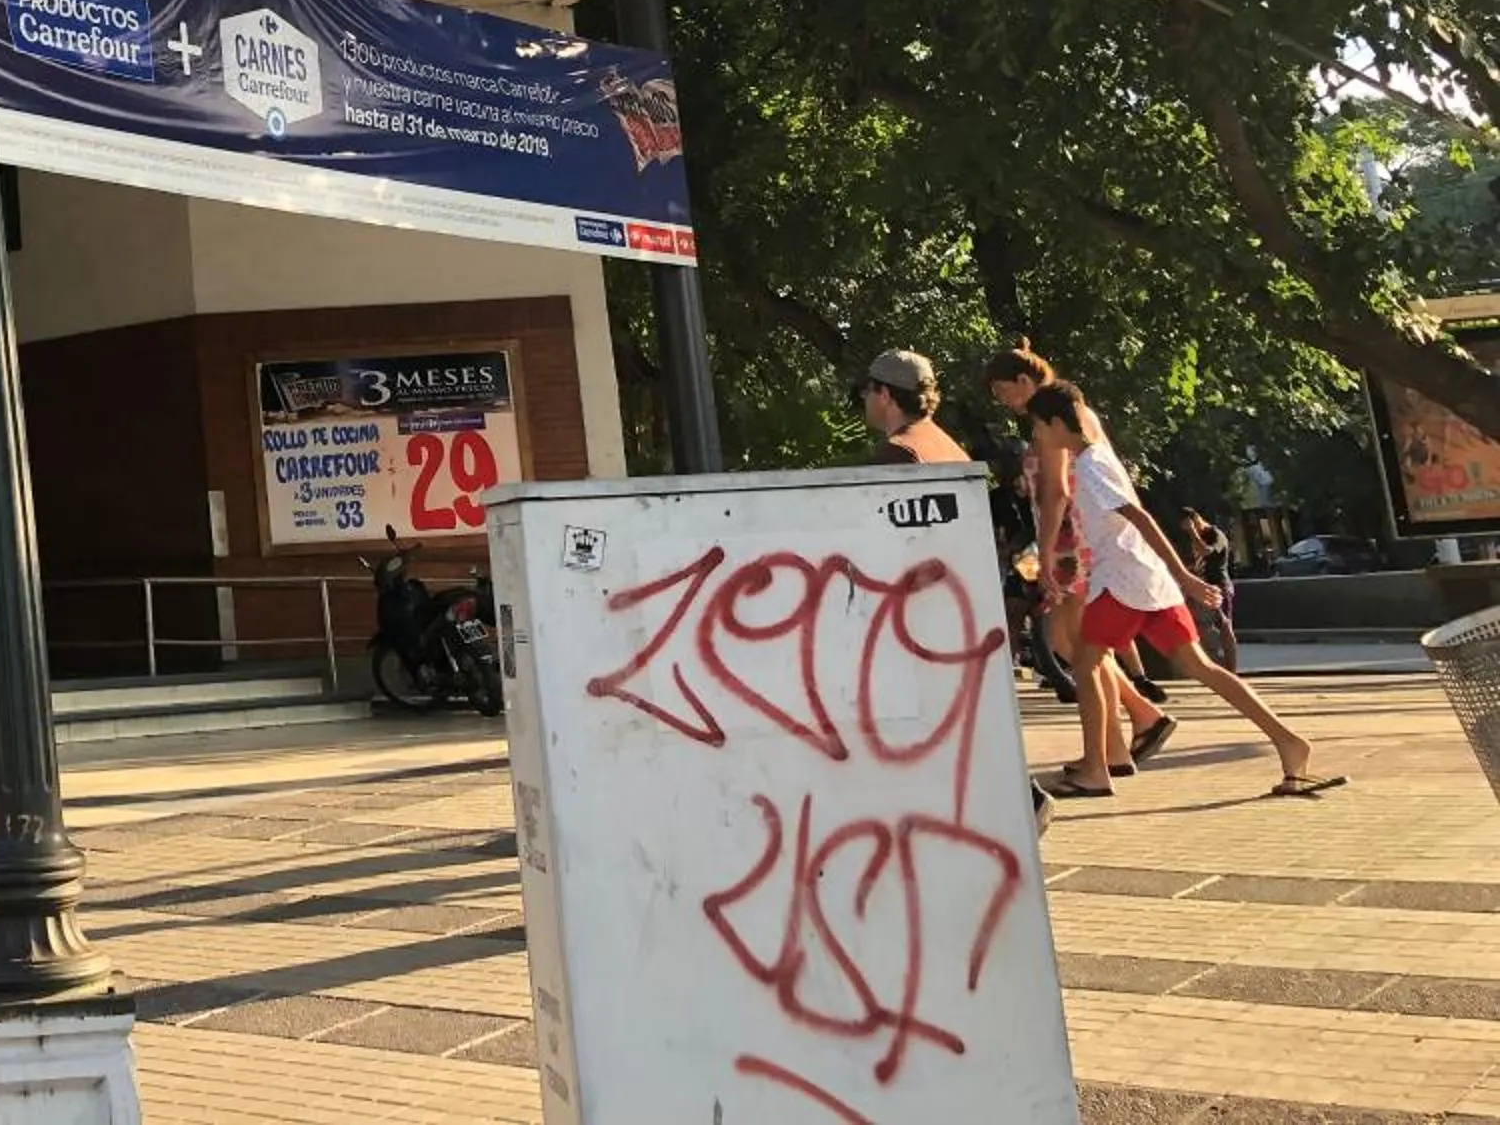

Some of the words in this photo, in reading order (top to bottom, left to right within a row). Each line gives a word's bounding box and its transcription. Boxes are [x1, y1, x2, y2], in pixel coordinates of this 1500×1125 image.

[19, 12, 142, 65] Carrefour
[235, 34, 307, 81] CARNES
[238, 72, 310, 105] Carrefour
[344, 100, 389, 130] hasta
[391, 112, 405, 133] el
[405, 114, 424, 136] 31
[425, 119, 447, 140] de
[447, 126, 499, 147] marzo
[500, 129, 517, 150] de
[360, 370, 391, 406] 3
[396, 366, 493, 388] MESES
[332, 423, 379, 446] COCINA
[276, 450, 381, 483] CARREFOUR
[406, 429, 499, 531] 29
[300, 481, 313, 503] 3
[336, 500, 365, 530] 33
